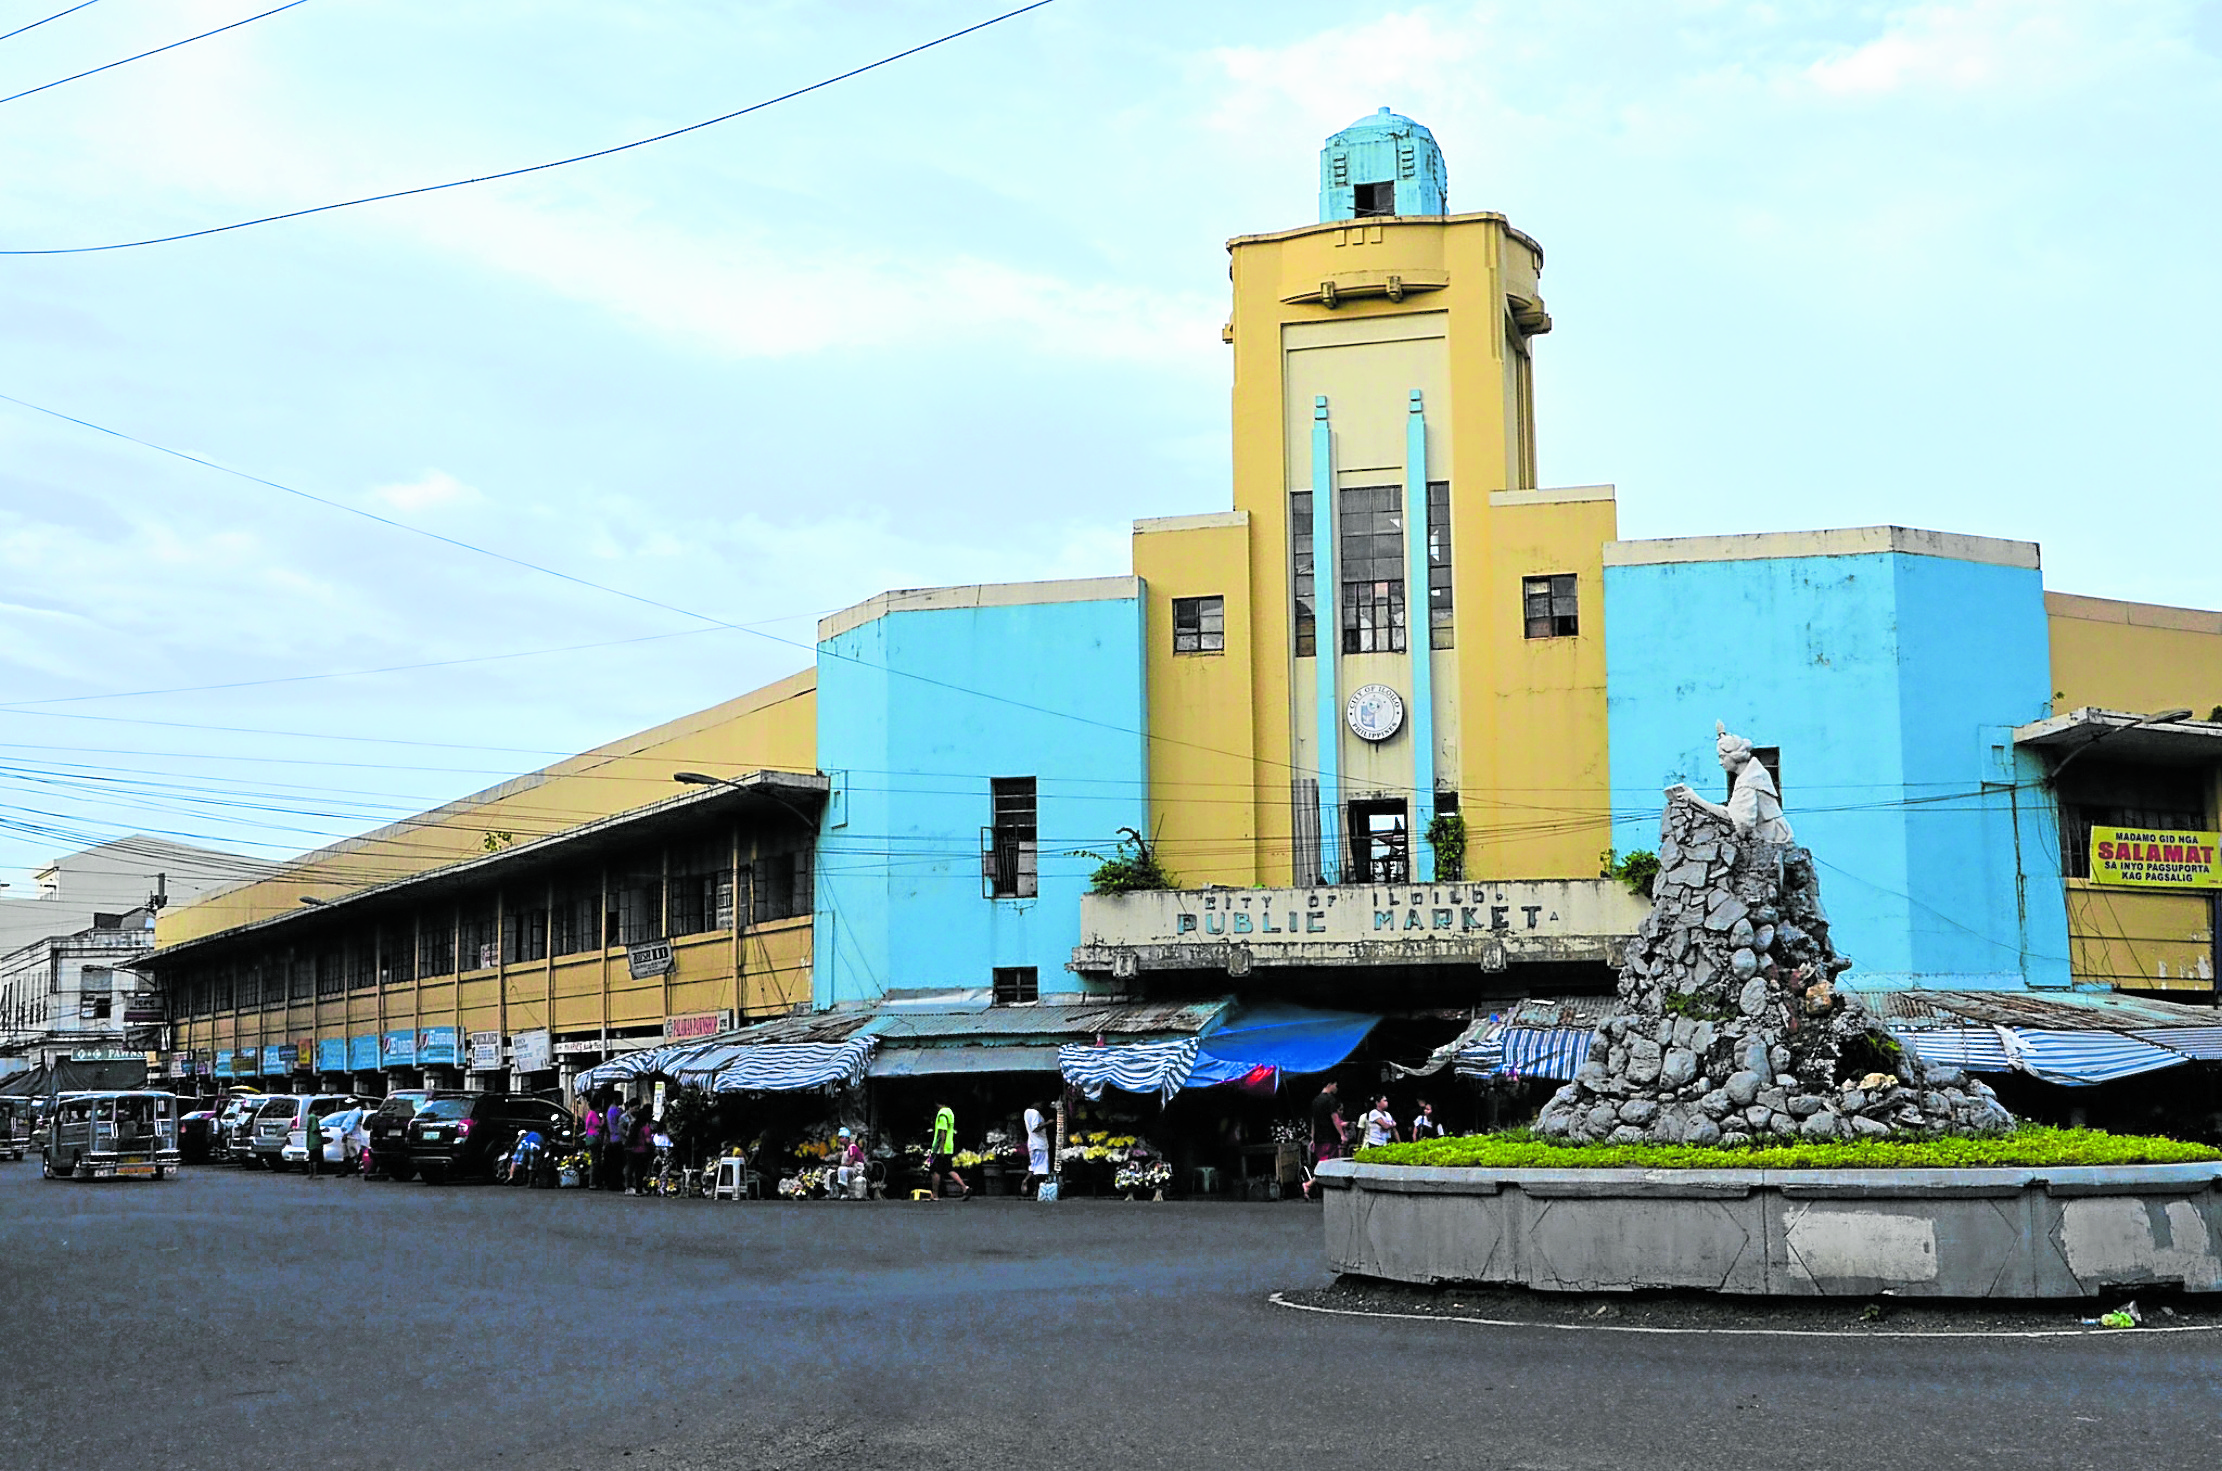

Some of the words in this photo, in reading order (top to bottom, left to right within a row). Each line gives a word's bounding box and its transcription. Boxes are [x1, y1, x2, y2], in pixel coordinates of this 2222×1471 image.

[1350, 691, 1362, 709] CITY
[1378, 686, 1400, 708] ILOILO
[1352, 722, 1397, 738] PHILIPPINES
[2115, 832, 2156, 842] MADAMO
[2159, 834, 2175, 843] GID
[2178, 835, 2199, 844] NGA
[2098, 841, 2214, 864] SALAMAT
[2104, 861, 2117, 869] SA
[2120, 861, 2144, 871] INYO
[2147, 863, 2210, 873] PAGSUPORTA
[2121, 871, 2142, 880] KAG
[2145, 872, 2193, 882] PAGSALIG
[1205, 895, 1272, 910] CITY
[1308, 894, 1337, 908] OF
[1176, 911, 1326, 935] PUBLIC
[1374, 905, 1542, 932] MARKET
